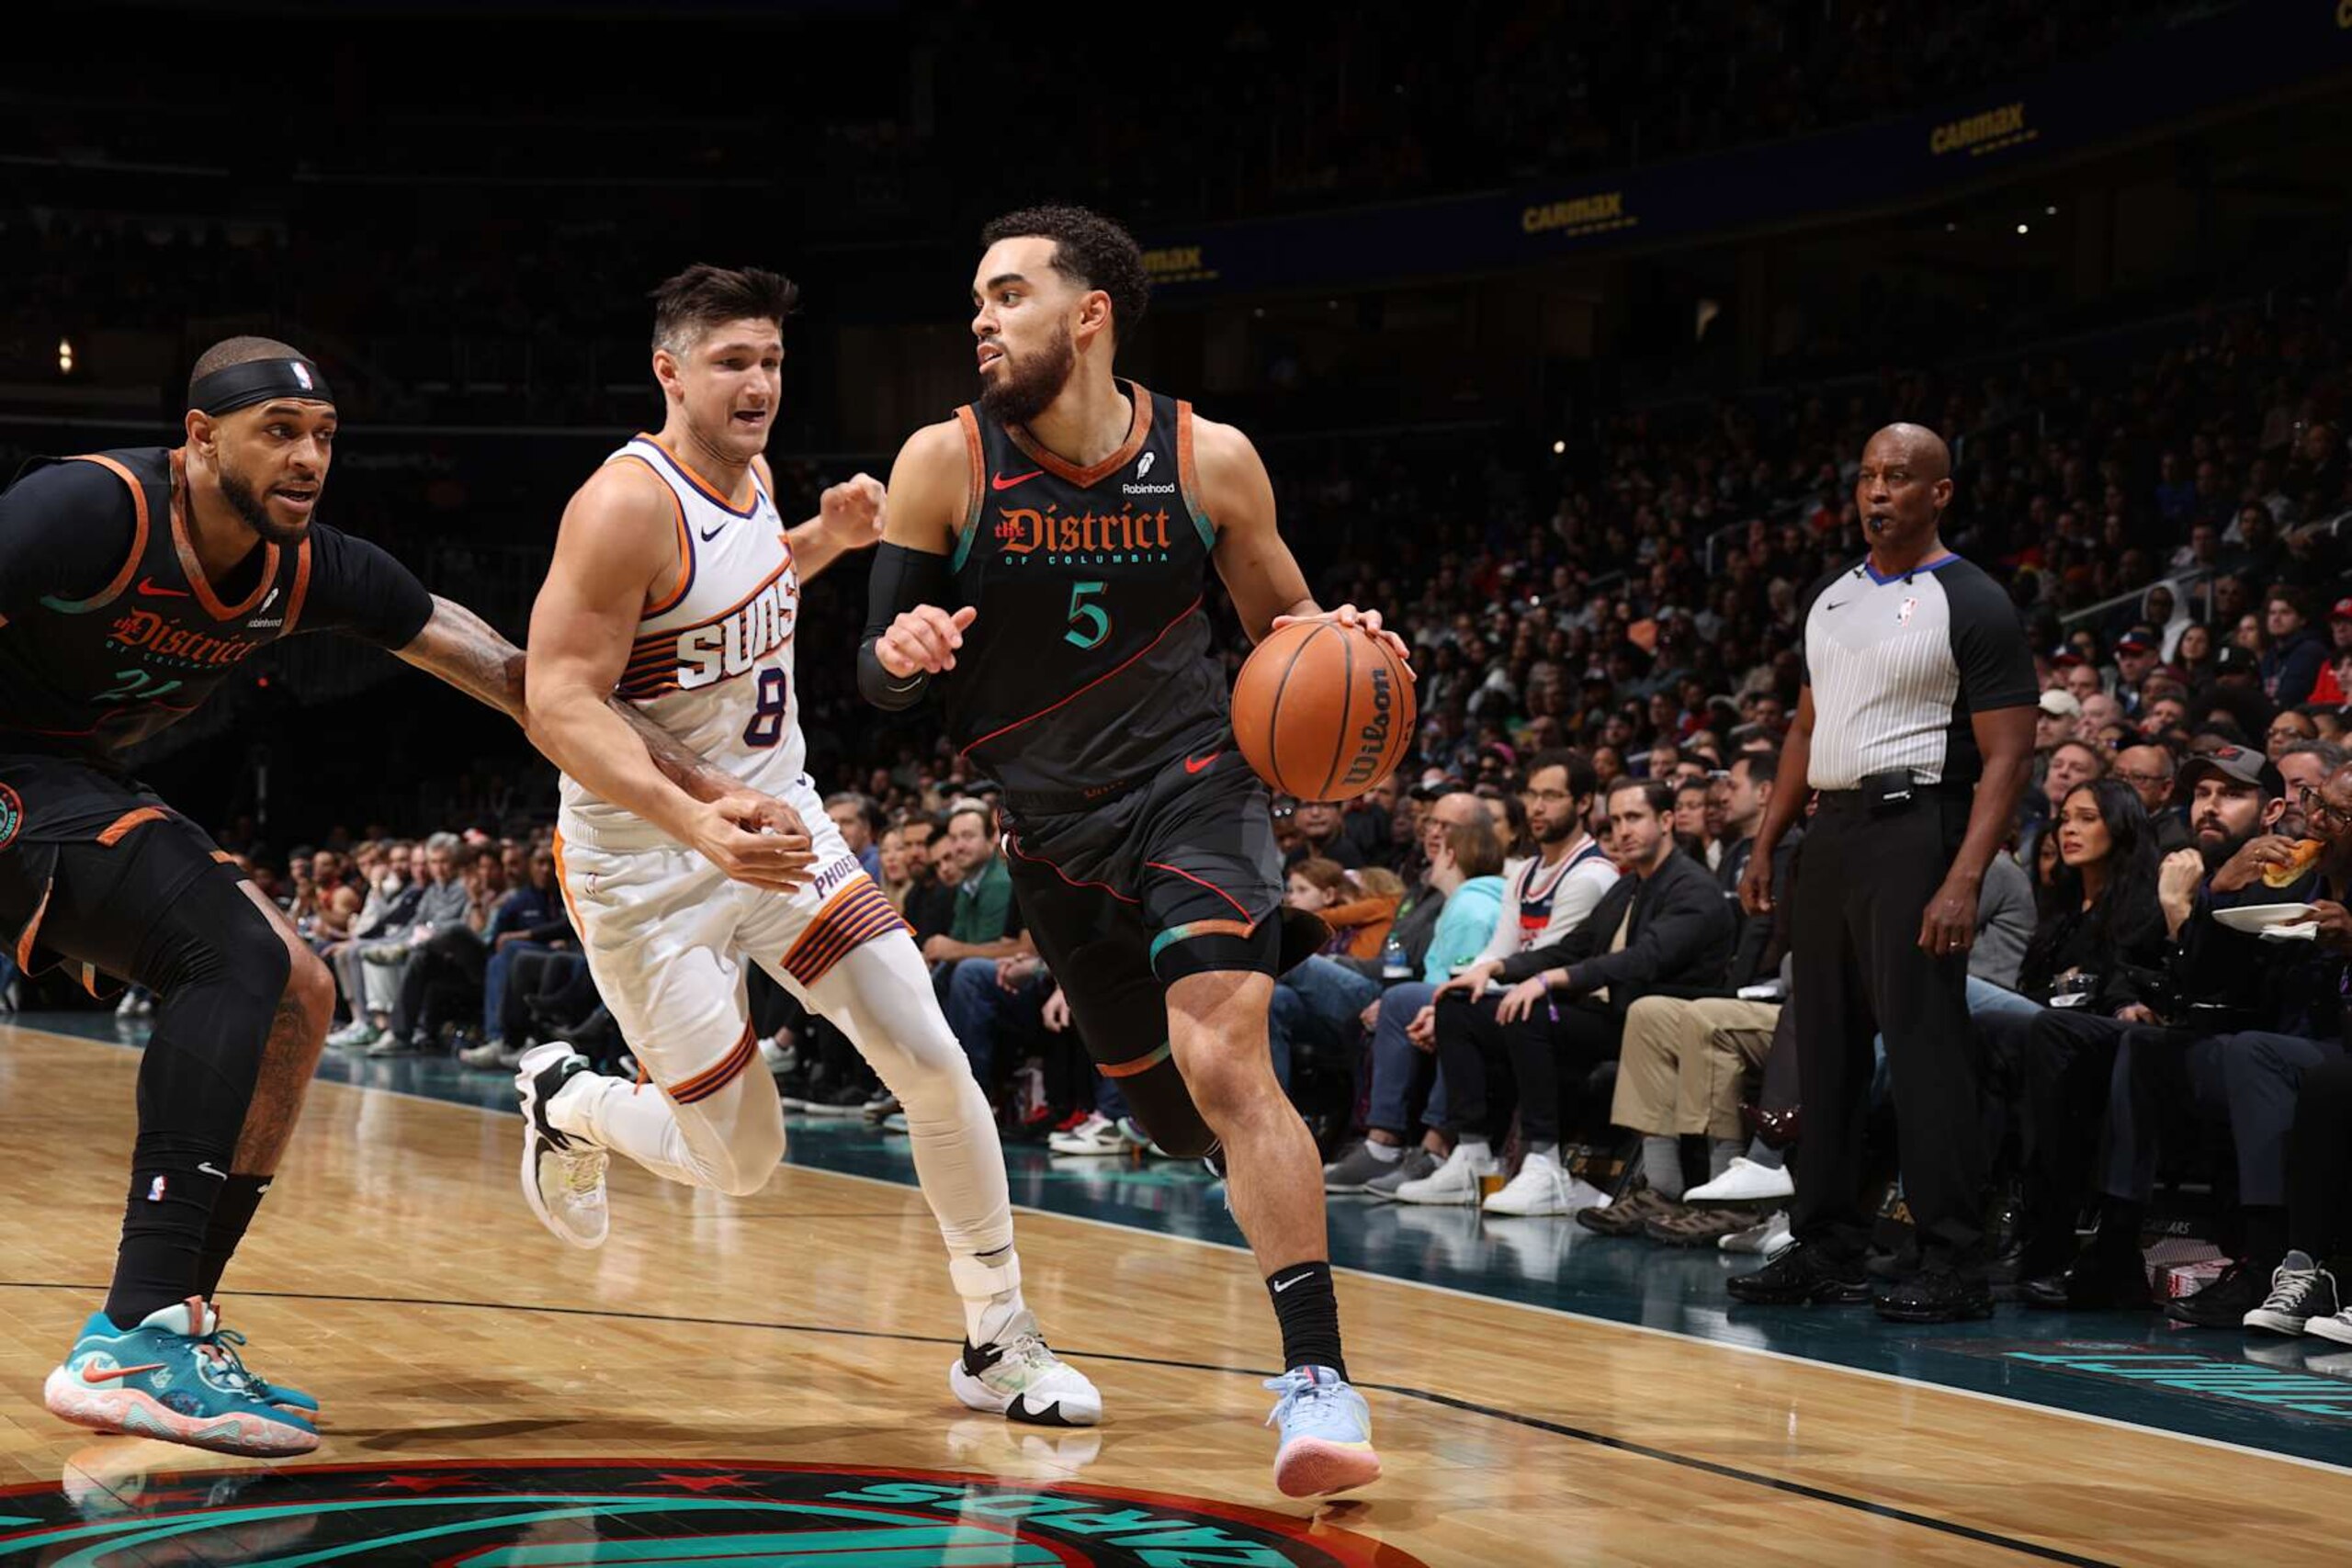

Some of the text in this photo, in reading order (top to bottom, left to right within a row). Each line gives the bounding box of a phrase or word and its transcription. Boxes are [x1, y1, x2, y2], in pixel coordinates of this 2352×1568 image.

[1141, 246, 1200, 272] max
[1123, 482, 1175, 495] Robinhood
[1000, 502, 1171, 554] District
[1005, 553, 1169, 566] OF COLUMBIA
[1064, 581, 1113, 650] 5
[742, 668, 786, 748] 8
[1342, 669, 1391, 784] Wilson
